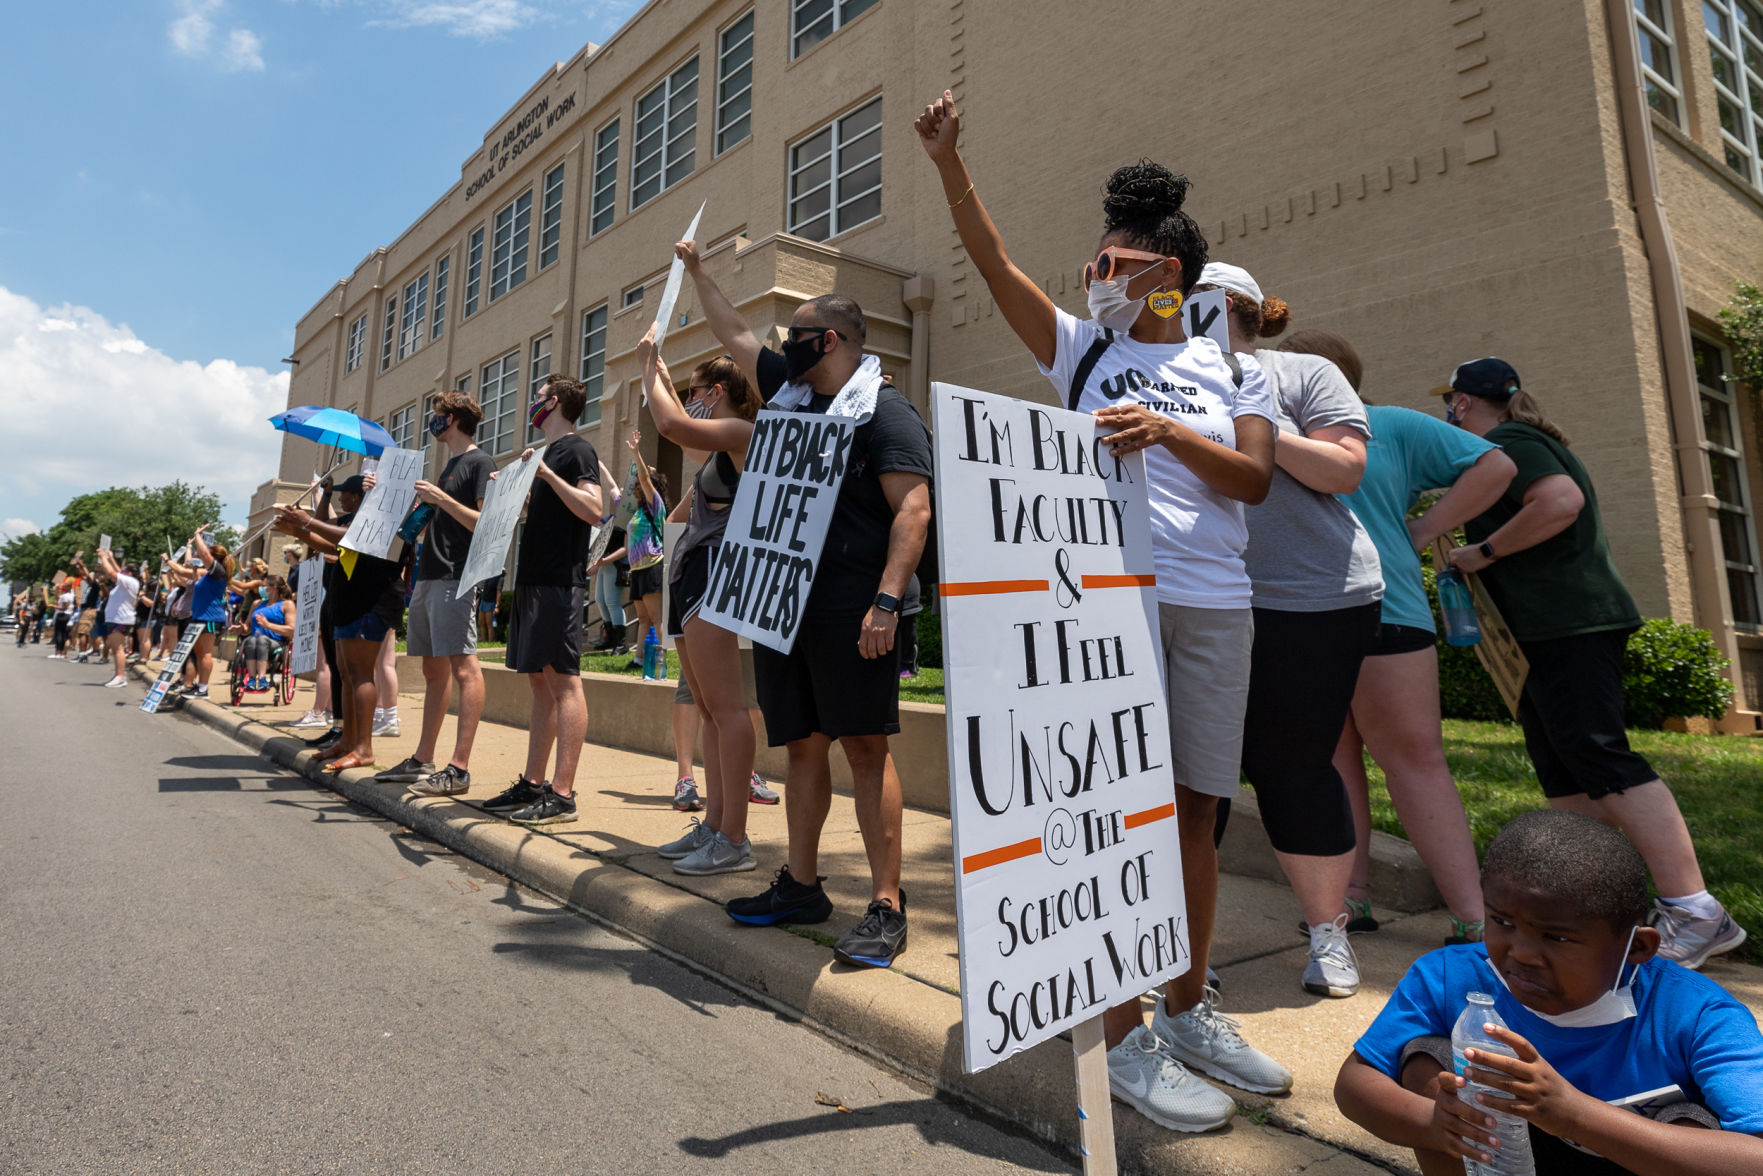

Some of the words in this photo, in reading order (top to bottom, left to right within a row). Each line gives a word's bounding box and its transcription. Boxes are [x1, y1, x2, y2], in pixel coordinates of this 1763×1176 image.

[465, 165, 496, 201] SCHOOL
[498, 151, 509, 172] OF
[512, 123, 543, 160] SOCIAL
[546, 91, 576, 129] WORK
[490, 142, 500, 161] UT
[502, 96, 549, 152] ARLINGTON
[952, 396, 1015, 467] I'M
[1027, 408, 1134, 484] BLACK
[1138, 401, 1208, 415] CIVILIAN
[744, 418, 786, 475] MY
[775, 417, 853, 487] BLACK
[749, 481, 818, 553] LIFE
[989, 477, 1128, 547] FACULTY
[706, 541, 813, 640] MATTERS
[1054, 548, 1082, 609] &
[1014, 621, 1049, 689] I
[1054, 618, 1134, 684] FEEL
[966, 702, 1163, 816] UNSAFE
[998, 876, 1109, 957] SCHOOL
[1120, 850, 1153, 907] OF
[987, 957, 1106, 1055] SOCIAL
[1102, 916, 1189, 987] WORK
